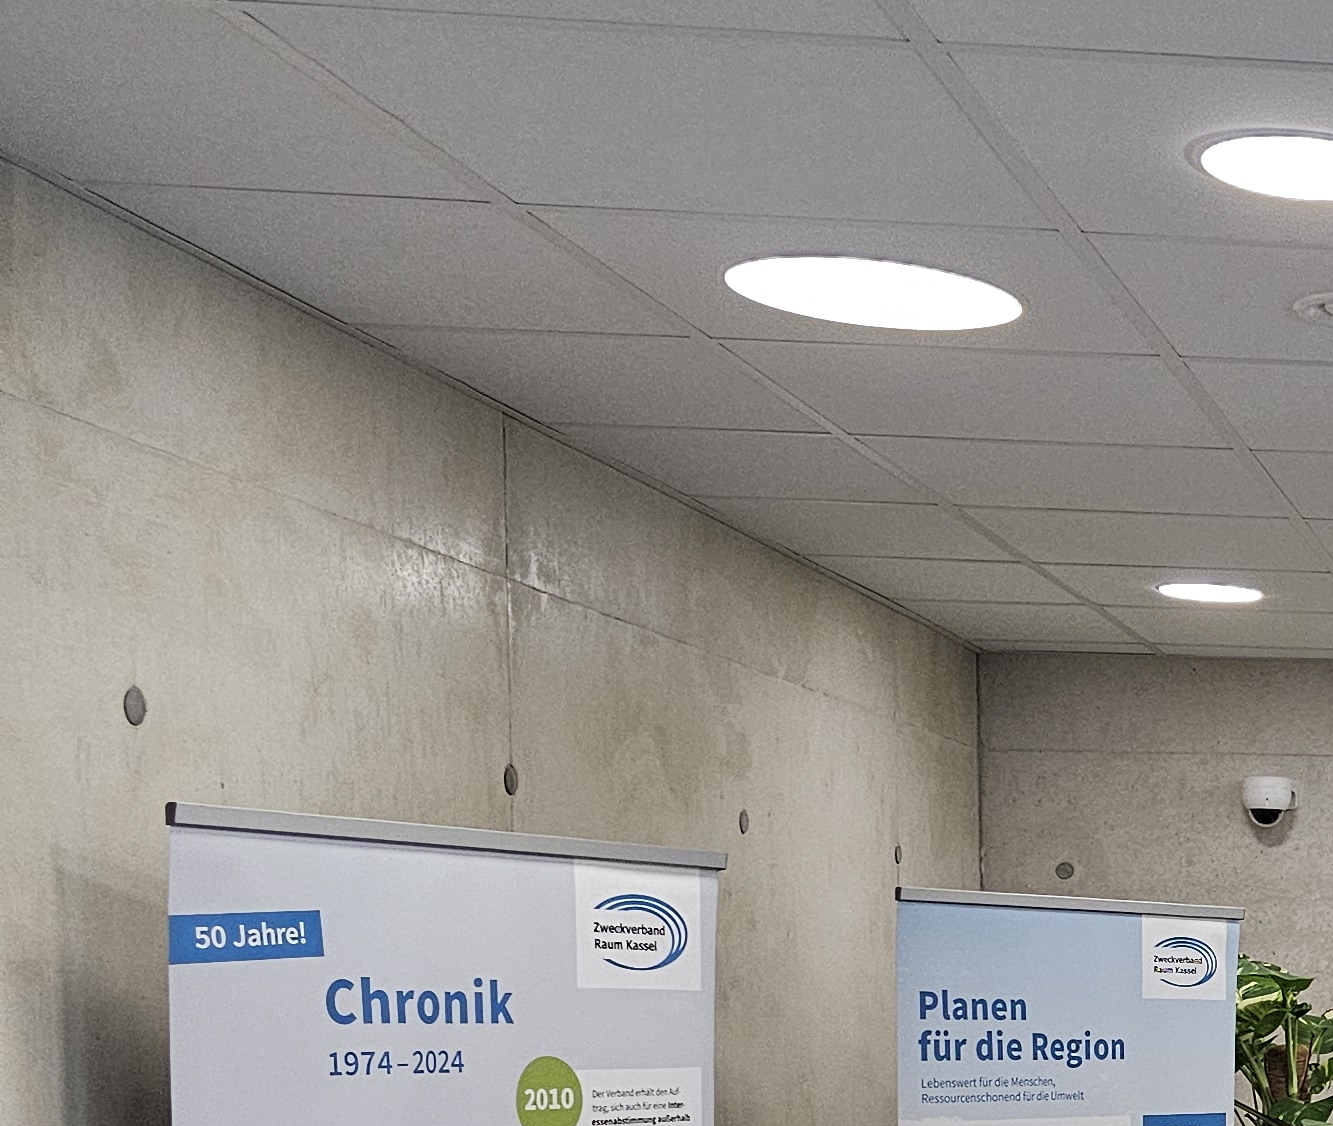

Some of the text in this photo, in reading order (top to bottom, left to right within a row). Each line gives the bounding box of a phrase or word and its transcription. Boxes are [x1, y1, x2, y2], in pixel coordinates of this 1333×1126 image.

[195, 922, 307, 949] 50 Jahre!
[593, 922, 666, 939] Zweckverband
[594, 938, 658, 953] Raum Kassel
[1153, 955, 1203, 966] Zweckverband
[1153, 965, 1173, 974] Raum
[325, 977, 515, 1026] Chronik
[919, 989, 1028, 1021] Planen
[918, 1029, 1126, 1069] für die Region
[921, 1076, 1056, 1089] Lebenswert für die Menschen,
[524, 1087, 575, 1111] 2010
[921, 1090, 1085, 1104] Ressourcenschonend für die Umwelt
